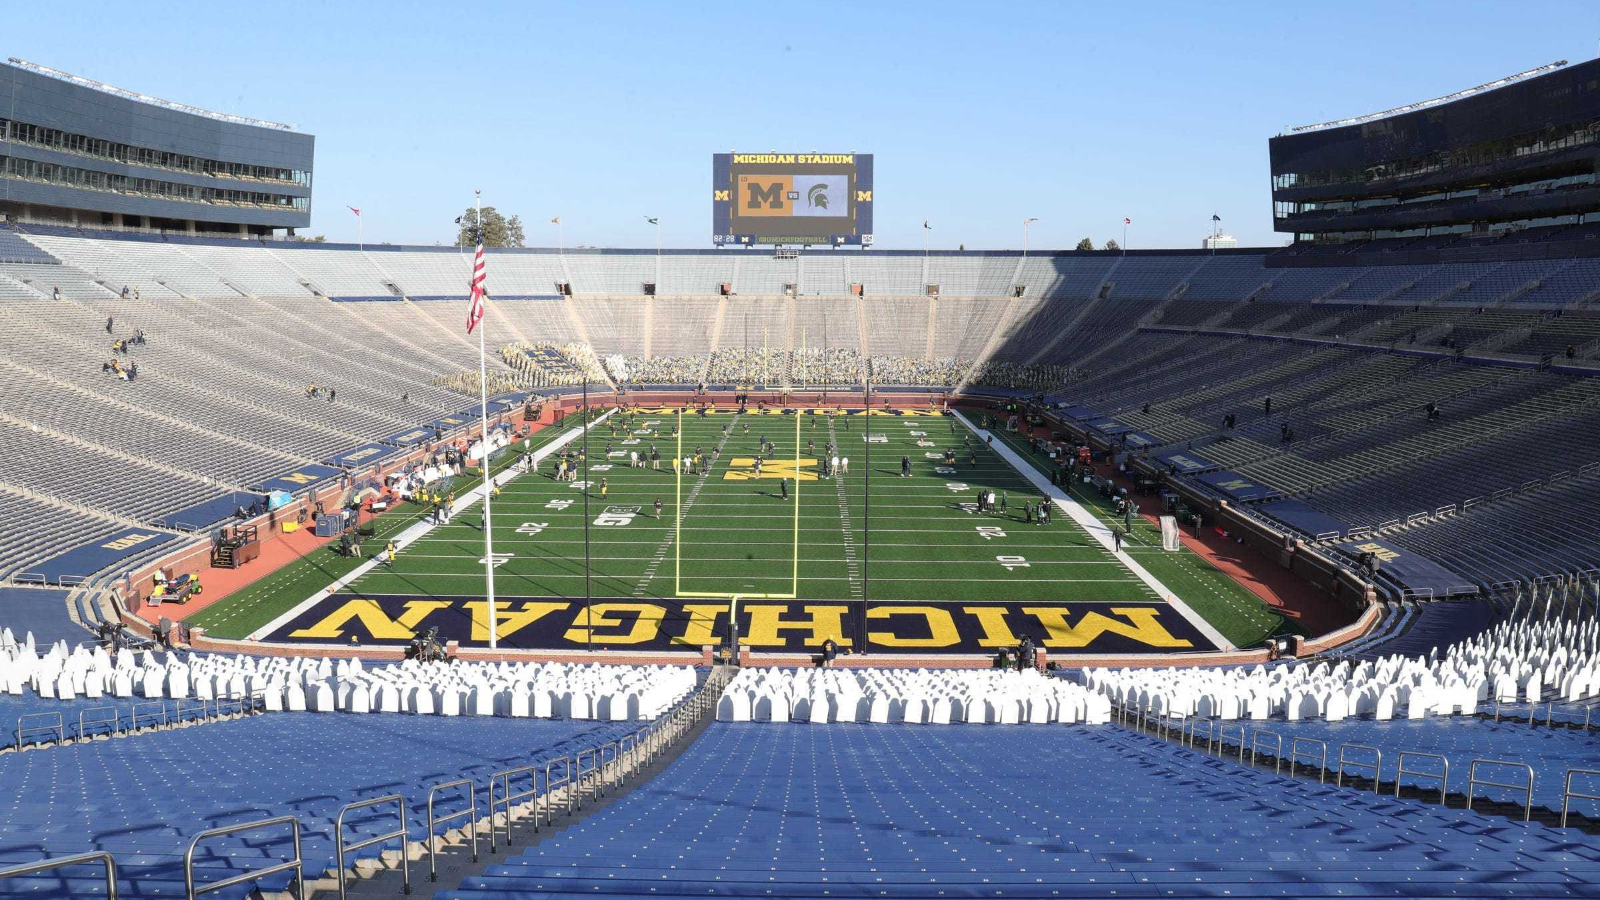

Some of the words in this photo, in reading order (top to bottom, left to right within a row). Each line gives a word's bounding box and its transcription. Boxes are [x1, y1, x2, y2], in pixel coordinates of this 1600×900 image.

[733, 155, 795, 164] MICHIGAN
[798, 155, 854, 164] STADIUM
[714, 190, 729, 201] M
[748, 183, 783, 208] M
[857, 190, 872, 201] M
[996, 555, 1031, 568] 10
[288, 599, 1194, 648] MICHIGAN
